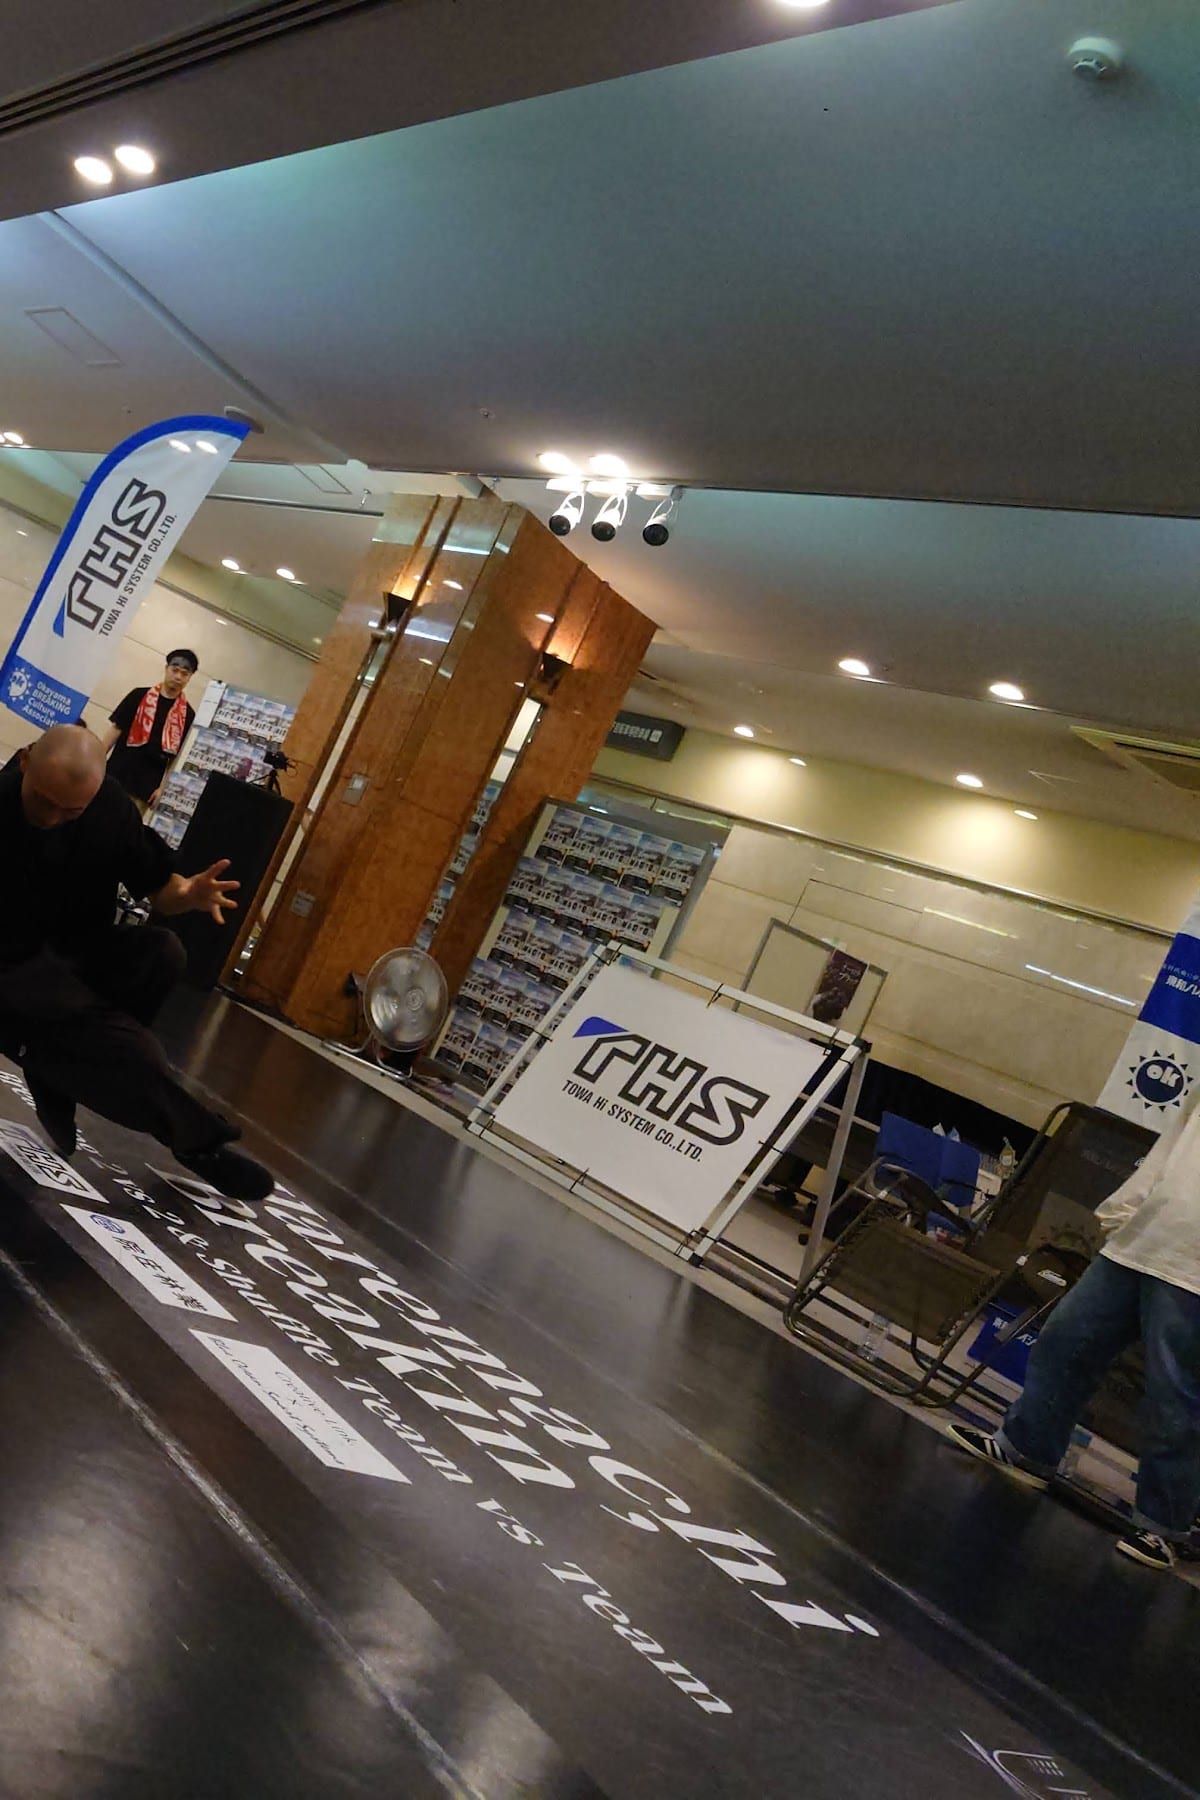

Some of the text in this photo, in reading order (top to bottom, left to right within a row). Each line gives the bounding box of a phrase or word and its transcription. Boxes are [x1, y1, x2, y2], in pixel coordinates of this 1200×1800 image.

[98, 609, 122, 637] TOWA
[124, 553, 152, 595] SYSTEM
[22, 704, 59, 728] Associat
[28, 697, 56, 718] Culture
[32, 689, 71, 715] BREAKING
[561, 1079, 594, 1105] TOWA
[593, 1096, 609, 1112] Hi
[607, 1103, 656, 1136] SYSTEM
[142, 1205, 185, 1226] 2
[196, 1252, 340, 1367] Shuffle
[334, 1375, 473, 1484] Team
[476, 1498, 544, 1547] vs
[542, 1562, 733, 1714] Team
